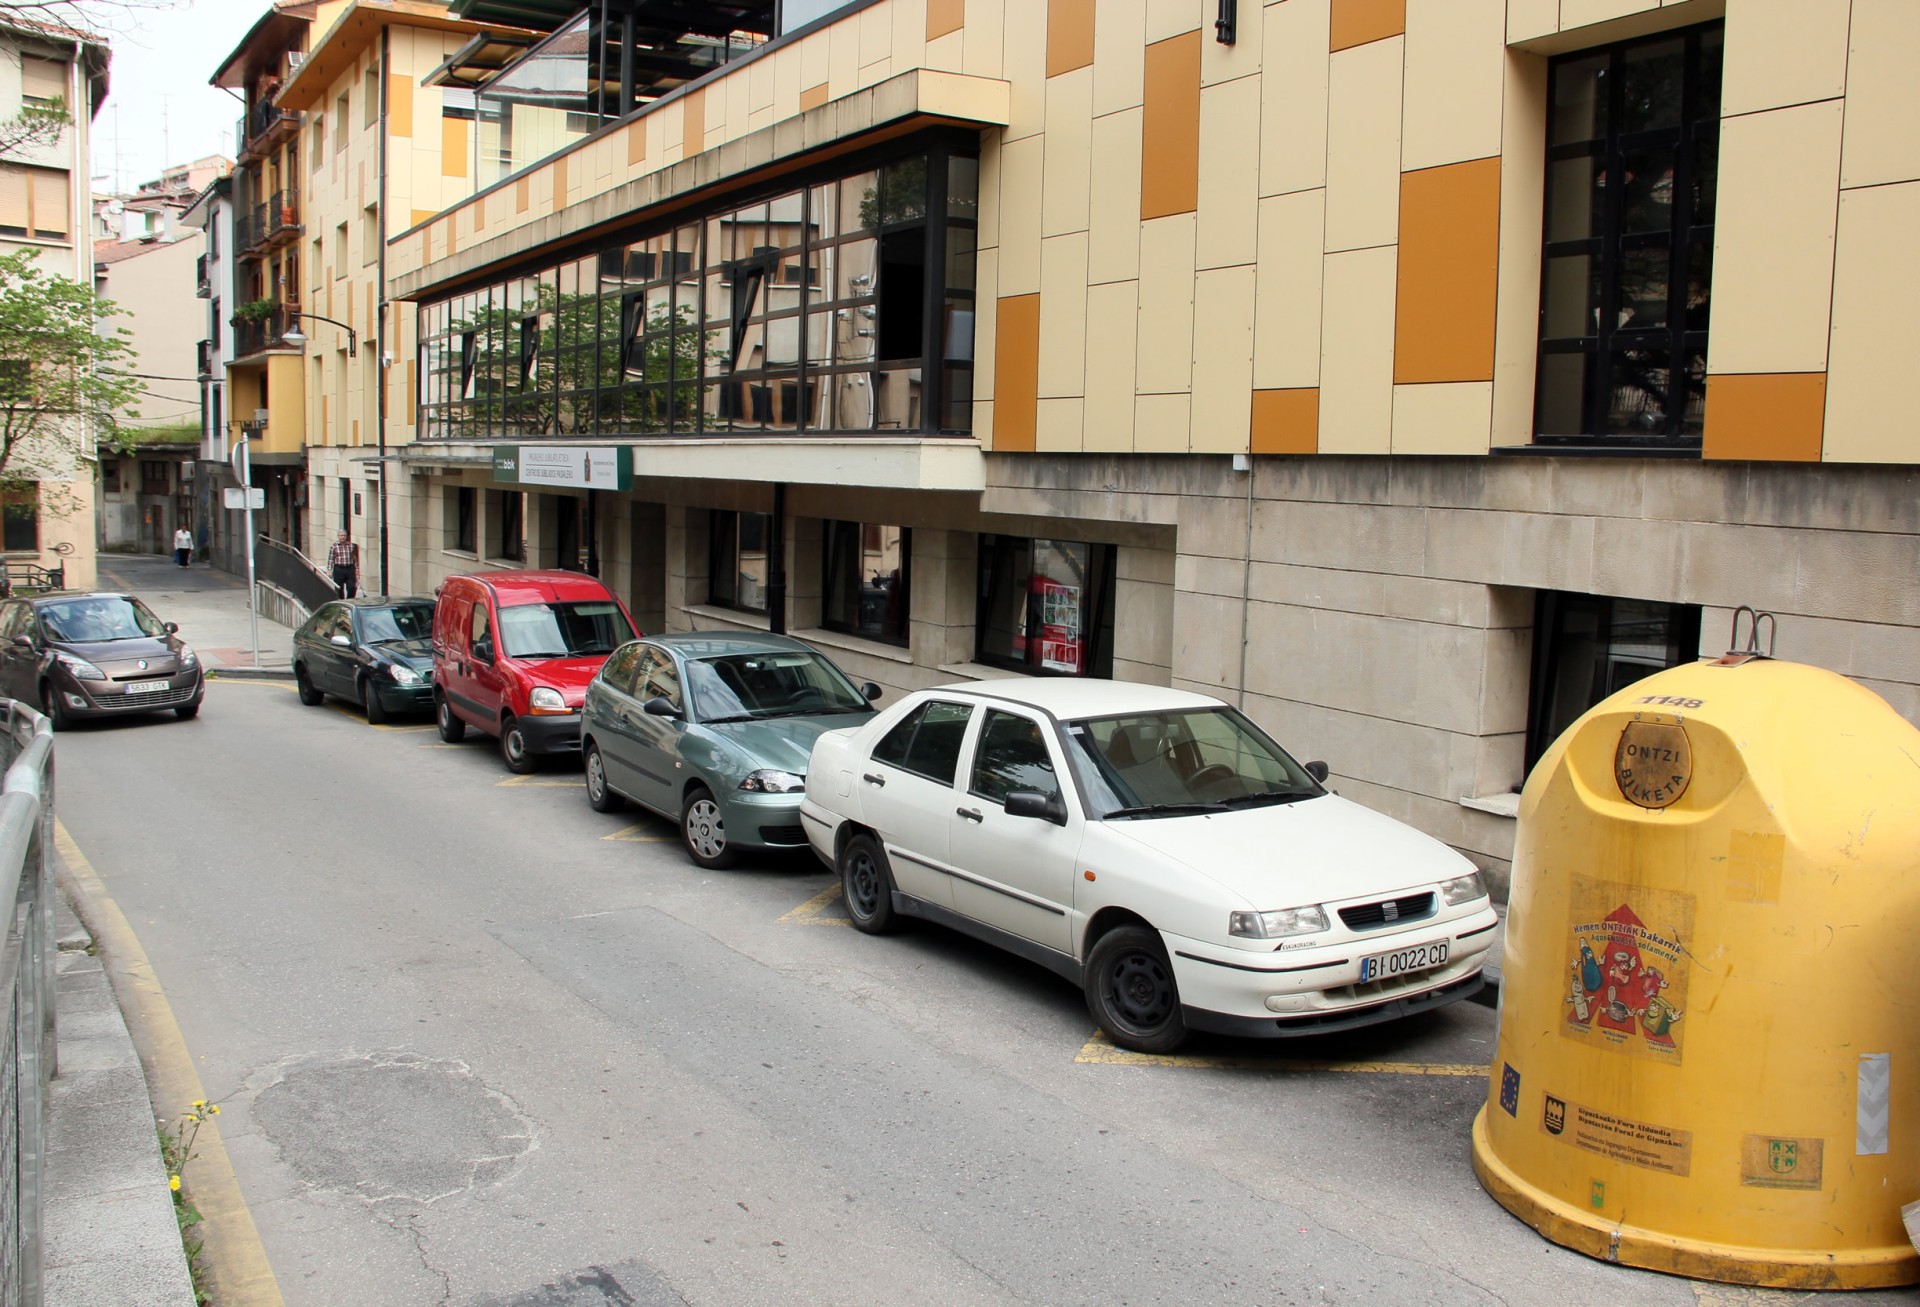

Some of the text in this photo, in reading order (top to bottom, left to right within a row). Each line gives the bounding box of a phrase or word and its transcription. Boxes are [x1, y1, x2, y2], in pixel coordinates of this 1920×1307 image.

[503, 459, 516, 470] bbk
[1641, 696, 1704, 708] 1148
[1627, 744, 1679, 763] ONTZI
[1621, 768, 1683, 801] BILKETA
[1573, 922, 1682, 955] Hemen ONTZIAK bakarrik
[1389, 948, 1426, 973] 0022
[1429, 944, 1448, 964] CD
[1638, 941, 1678, 963] solamente
[1578, 1107, 1672, 1138] Gipuzkoako Foru Aldundia
[1614, 1126, 1634, 1138] Foral
